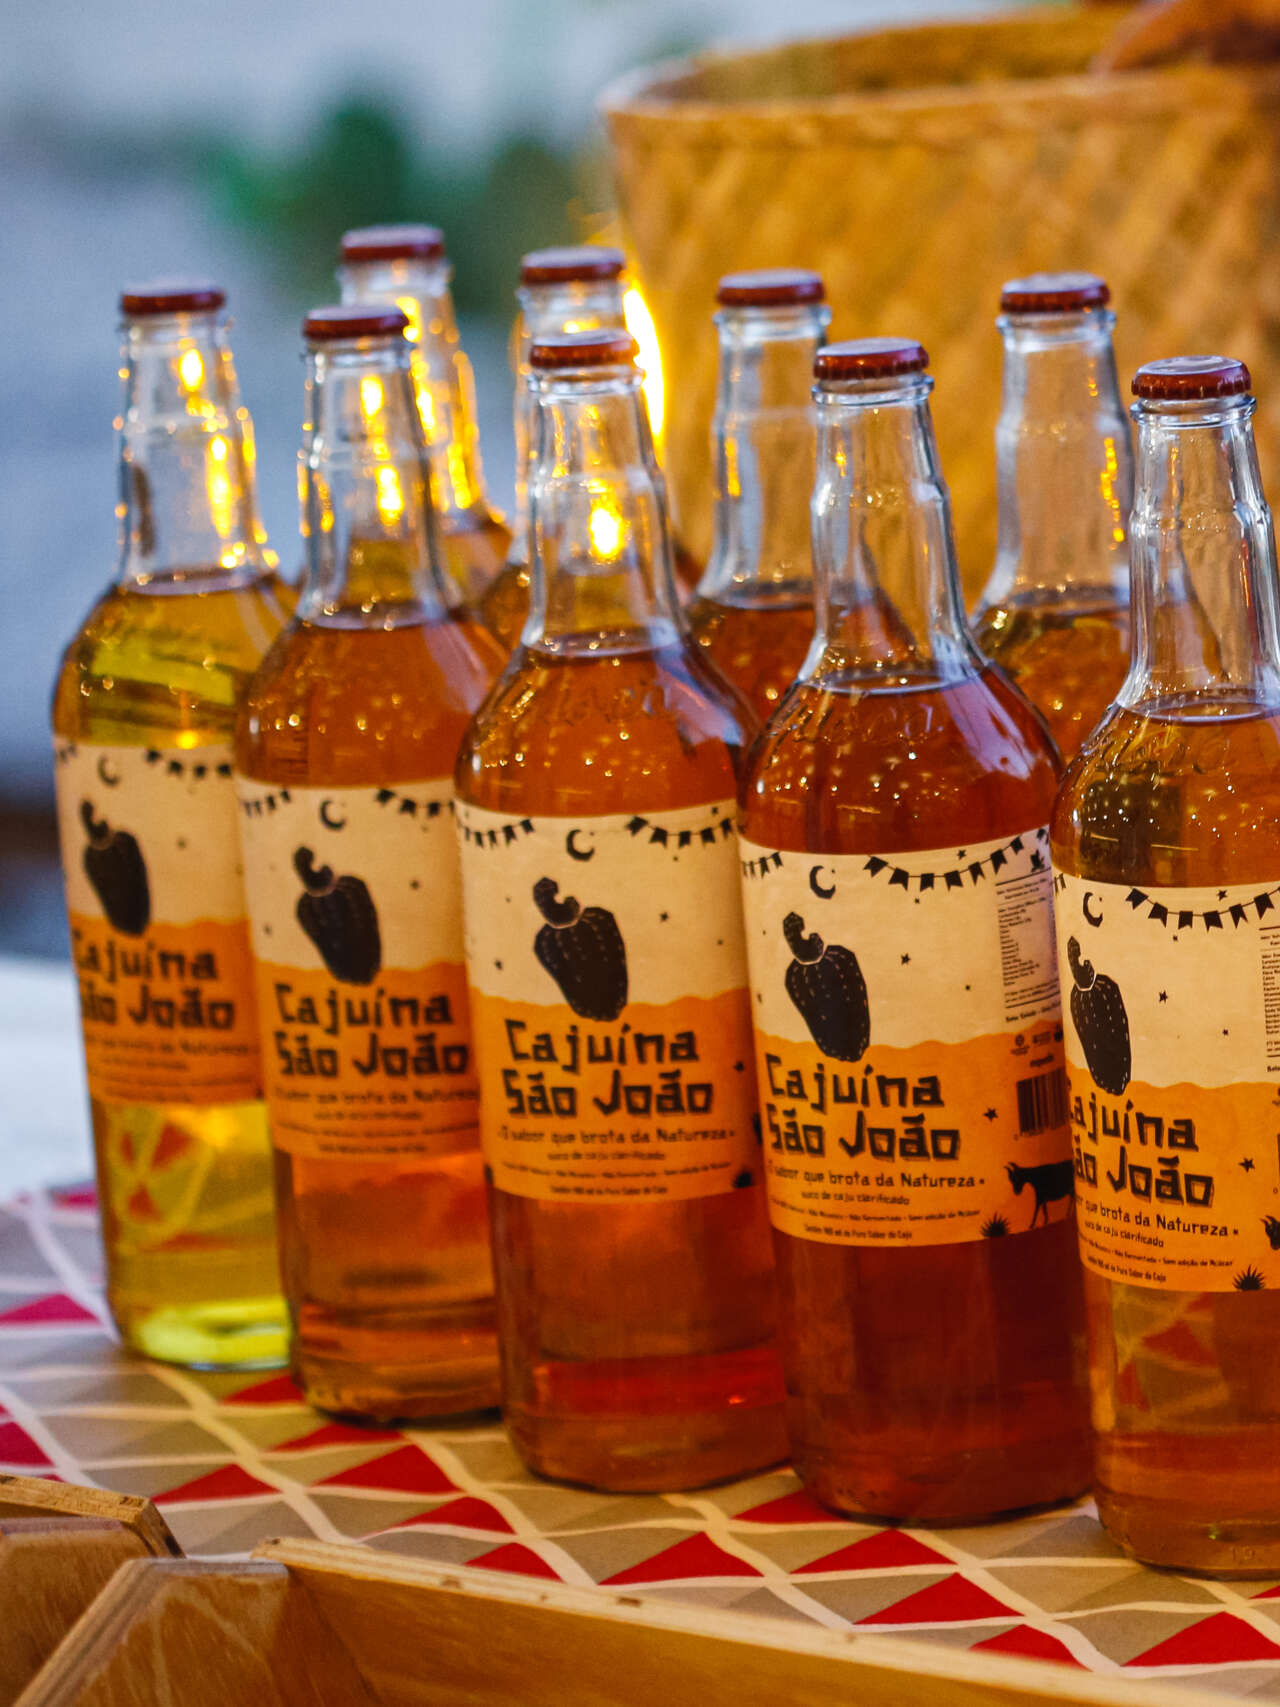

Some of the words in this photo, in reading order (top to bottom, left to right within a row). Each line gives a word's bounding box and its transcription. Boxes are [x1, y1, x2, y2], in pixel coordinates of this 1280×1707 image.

[128, 985, 235, 1030] João
[274, 982, 453, 1036] Cajuína
[274, 1031, 339, 1077] São
[353, 1033, 470, 1078] João
[505, 1018, 700, 1075] Cajuína
[502, 1068, 578, 1117] São
[593, 1069, 714, 1117] João
[766, 1053, 945, 1114] Cajuína
[580, 1128, 625, 1144] brota
[631, 1128, 650, 1143] da
[656, 1128, 726, 1143] Natureza
[766, 1103, 826, 1158] São
[839, 1110, 961, 1162] João
[1070, 1091, 1199, 1152] ajuína
[804, 1170, 825, 1186] que
[829, 1167, 870, 1187] brota
[875, 1172, 894, 1187] da
[900, 1172, 976, 1188] Natureza
[1073, 1134, 1098, 1189] ão
[1107, 1145, 1215, 1208] João
[1100, 1201, 1131, 1223] brota
[1135, 1211, 1151, 1227] da
[1156, 1213, 1229, 1237] Natureza
